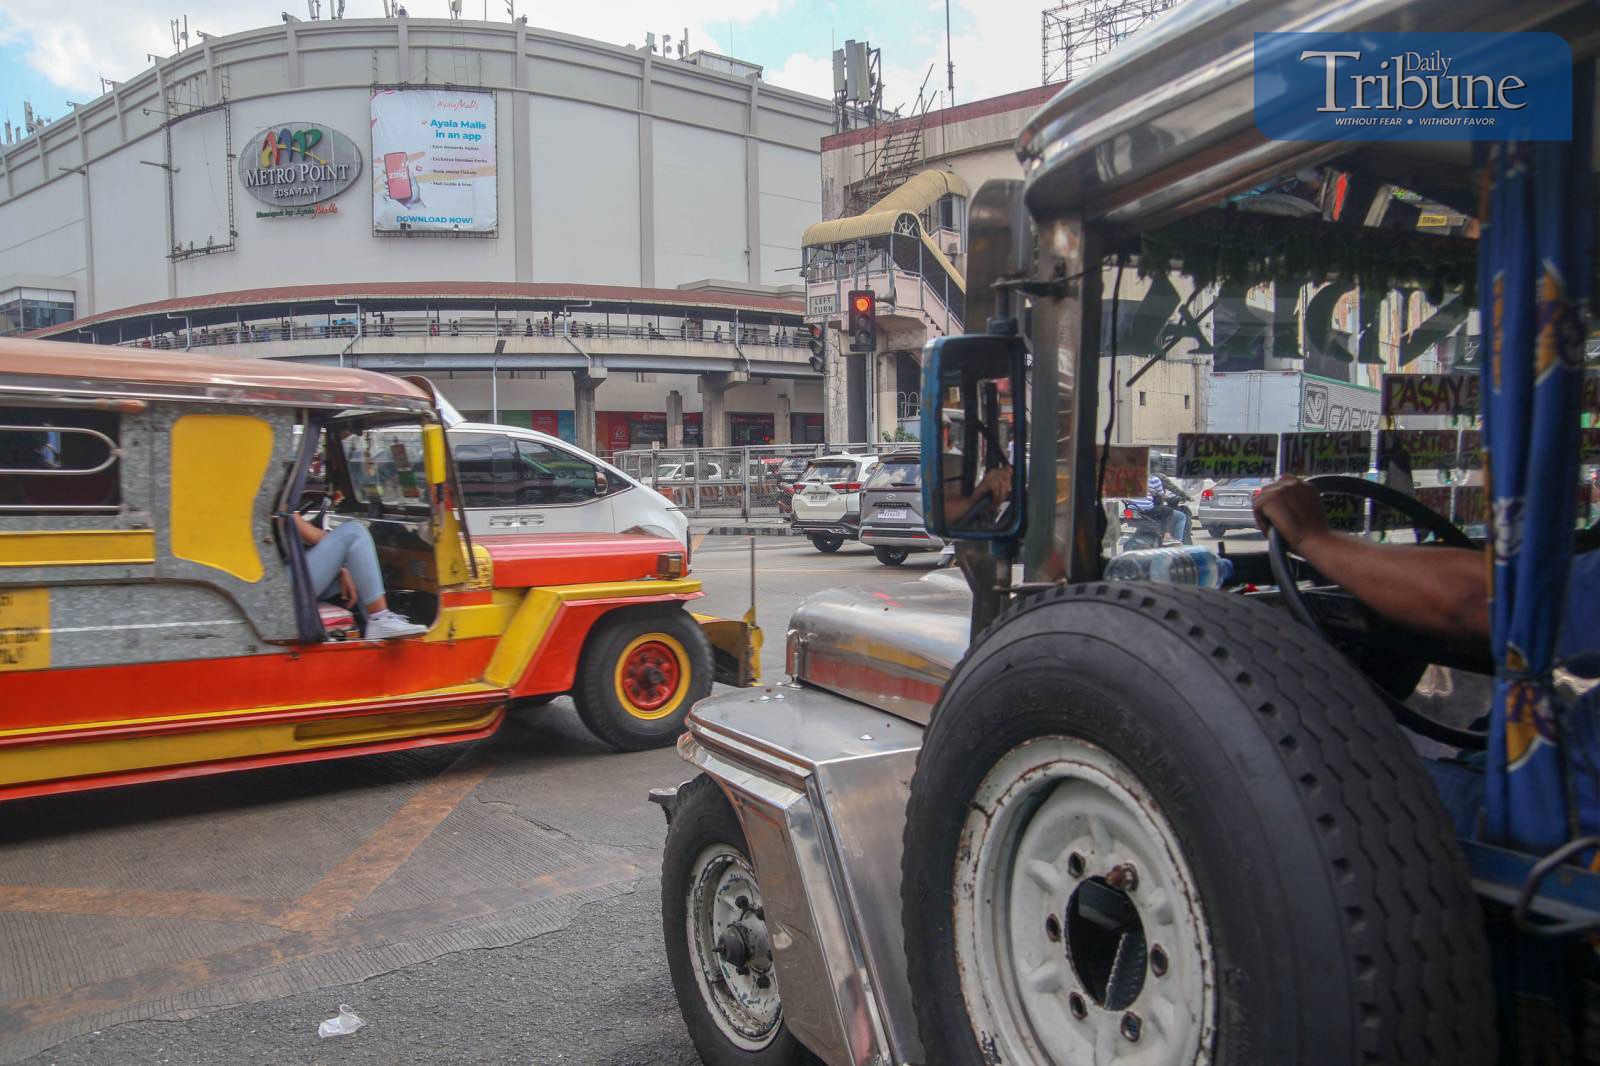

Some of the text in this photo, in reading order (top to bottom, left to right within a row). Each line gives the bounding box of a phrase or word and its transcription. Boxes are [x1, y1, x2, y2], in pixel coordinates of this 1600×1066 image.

[430, 120, 487, 129] Ayala Malls
[435, 130, 445, 138] in
[462, 133, 482, 142] app
[246, 163, 349, 188] METRO POINT
[396, 216, 473, 224] DOWNLOAD NOW!
[814, 296, 831, 306] LEFT
[814, 305, 833, 314] TURN
[1385, 374, 1465, 415] PASAY
[1182, 434, 1275, 457] PEDRO GIL
